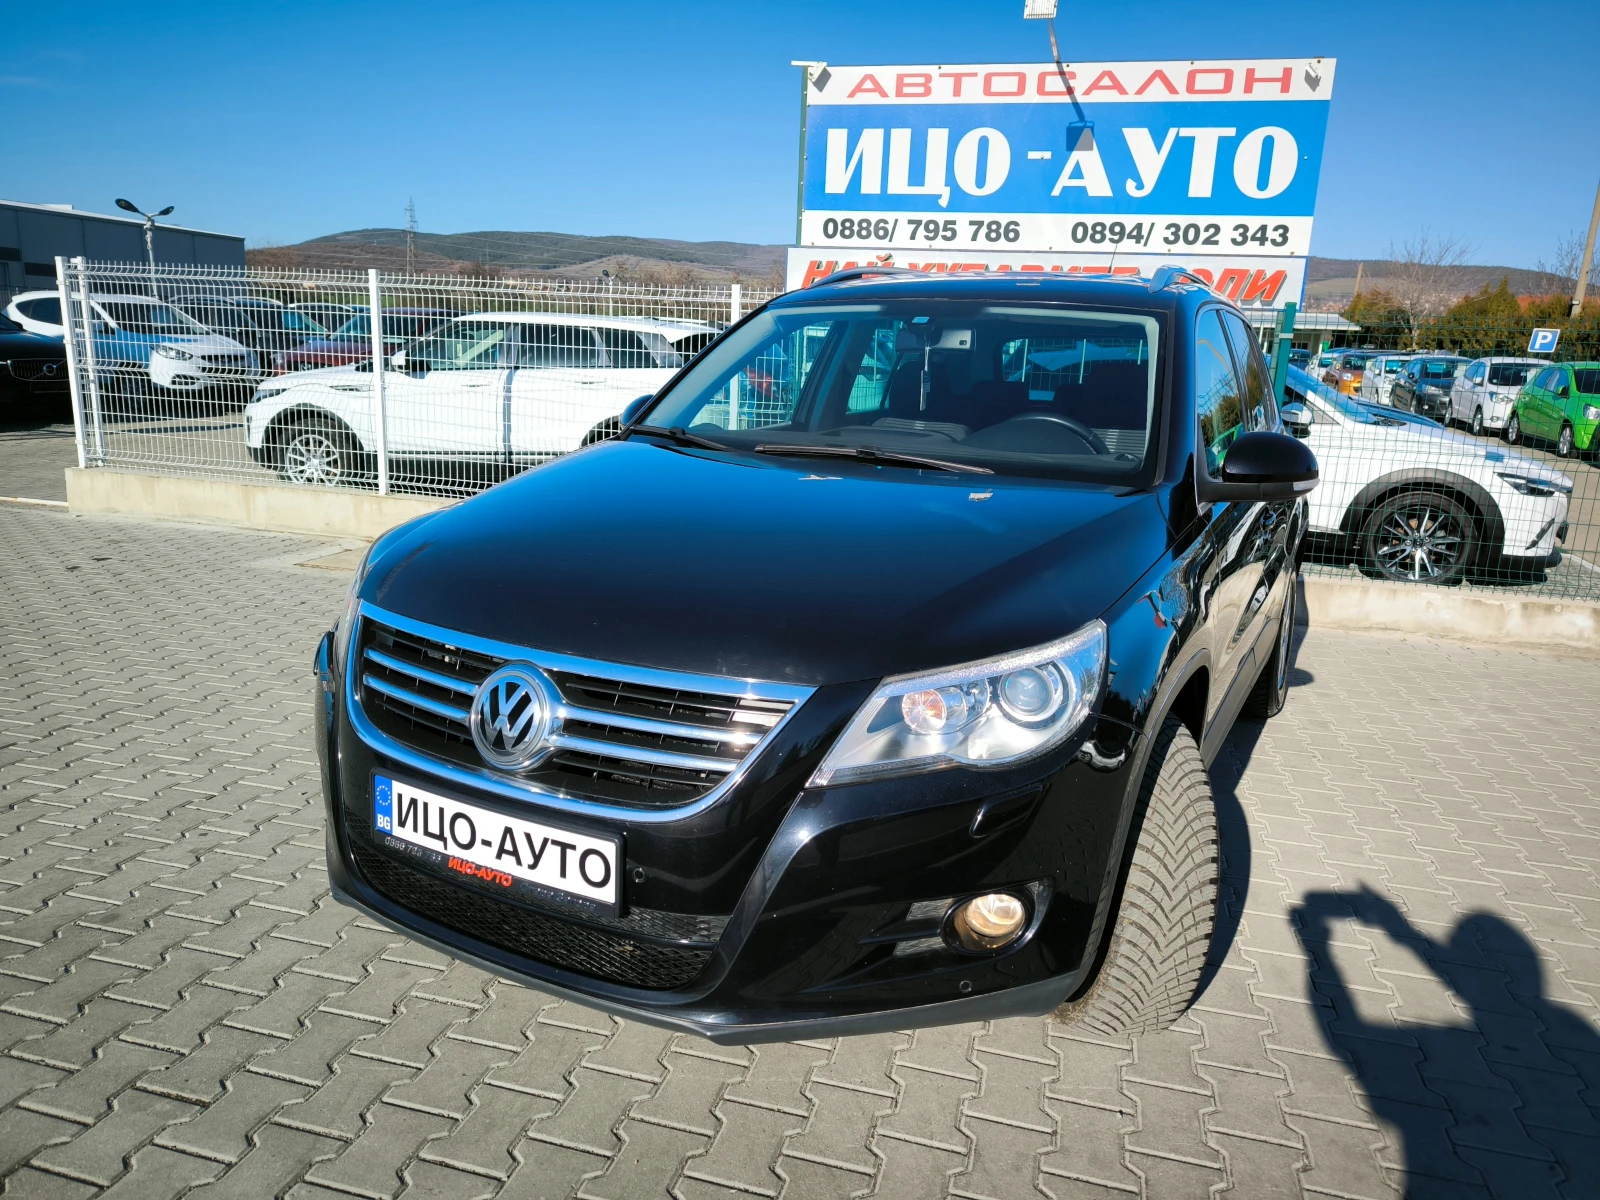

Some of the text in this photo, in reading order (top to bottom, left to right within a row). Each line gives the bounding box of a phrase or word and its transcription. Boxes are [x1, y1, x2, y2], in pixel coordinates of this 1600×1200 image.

[847, 67, 1293, 99] АВТОСАЛОН
[822, 217, 1021, 243] 0886/ 795 786
[1071, 221, 1290, 247] 0894/ 302 343
[1534, 332, 1553, 349] P
[377, 813, 391, 831] BG
[396, 792, 612, 888] ИЦО-АУТО
[448, 856, 513, 888] ИЦО-АУТО
